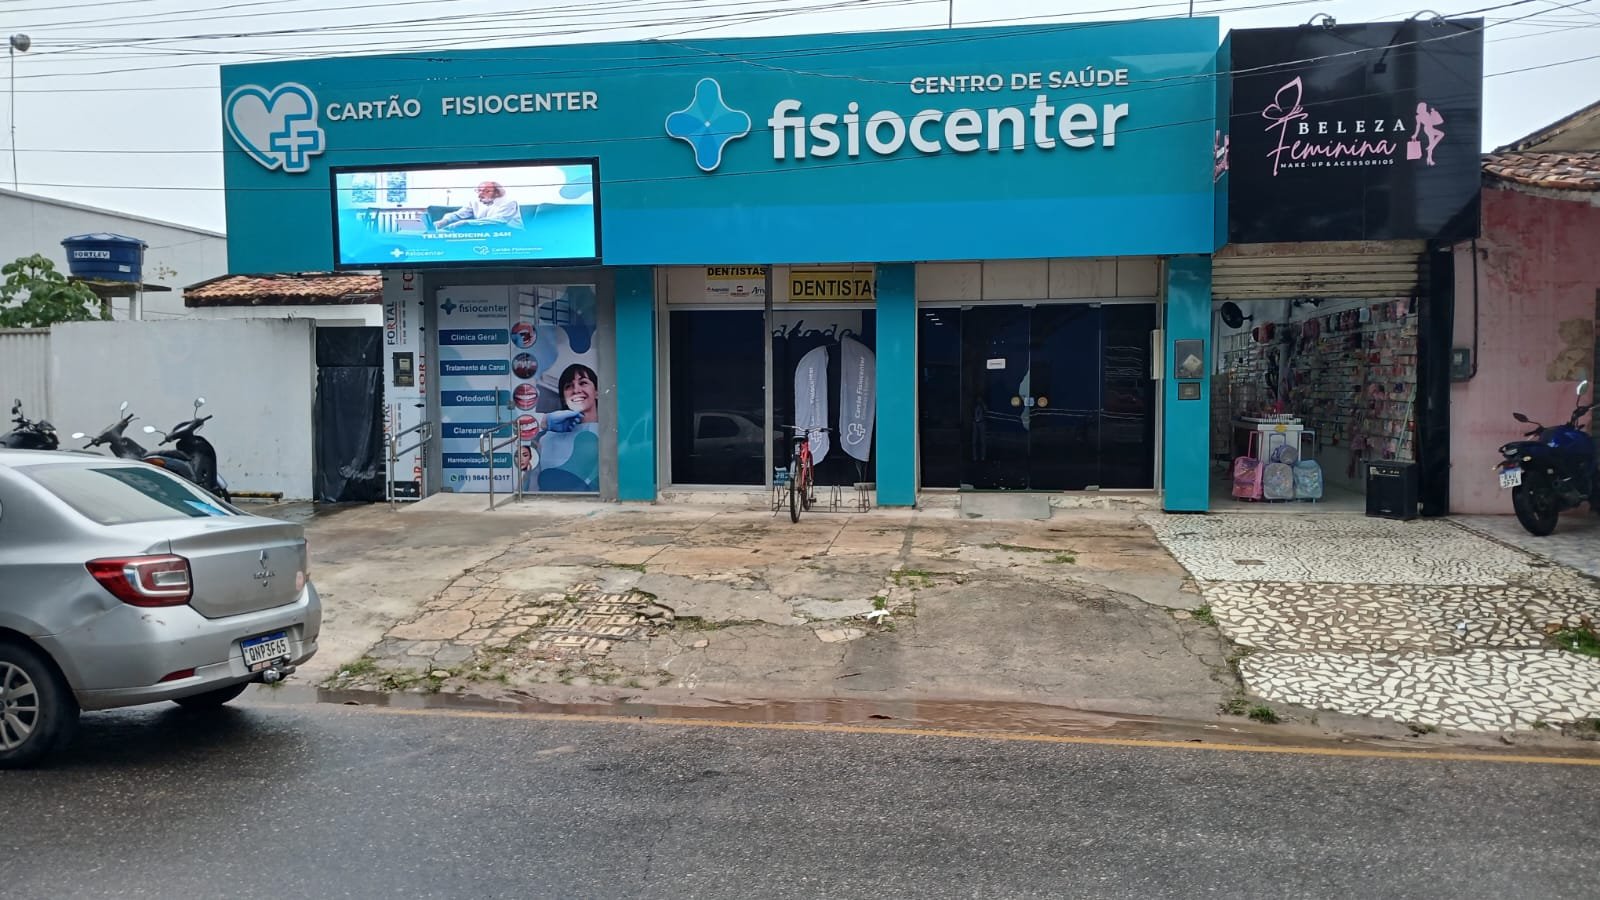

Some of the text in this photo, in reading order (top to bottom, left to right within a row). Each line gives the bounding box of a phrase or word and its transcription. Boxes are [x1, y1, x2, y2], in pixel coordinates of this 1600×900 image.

[910, 66, 1129, 95] CENTRO DE SAÚDE
[326, 90, 598, 121] CARTÃO FISIOCENTER
[768, 94, 1129, 161] fisiocenter
[1298, 119, 1406, 135] BELEZA
[1264, 112, 1398, 176] Feminina
[1334, 159, 1394, 168] ACESSORIOS
[422, 232, 490, 240] TELEMEDICINA
[707, 266, 766, 277] DENTISTAS
[792, 279, 878, 298] DENTISTA
[459, 303, 508, 313] fisiocenter
[386, 301, 397, 345] FORTAL
[477, 333, 497, 341] Geral
[456, 394, 495, 402] Ortodontia
[249, 639, 287, 661] QNP3F65
